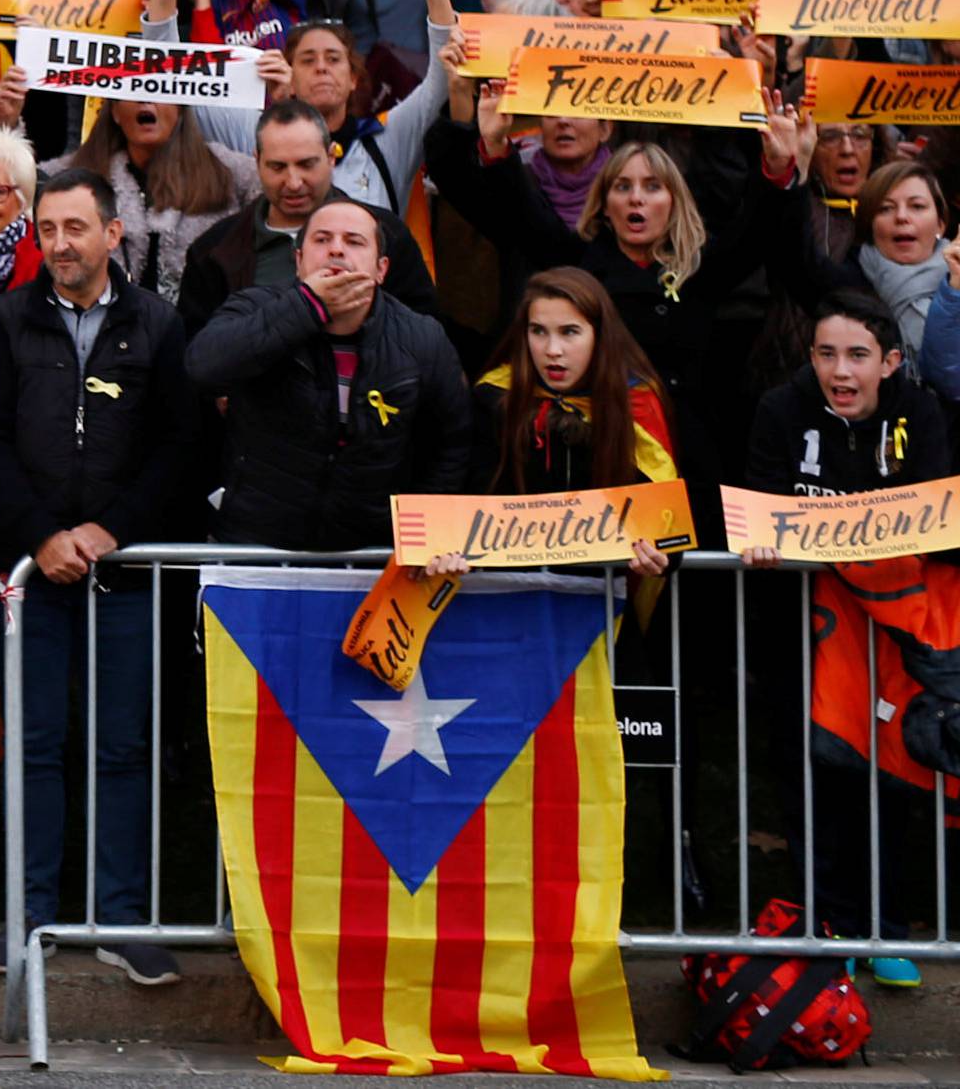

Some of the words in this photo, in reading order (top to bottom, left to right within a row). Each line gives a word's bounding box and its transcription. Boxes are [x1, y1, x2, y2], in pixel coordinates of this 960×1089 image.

[48, 38, 231, 77] LLIBERTAT
[579, 55, 624, 65] REPUBLIC
[627, 57, 639, 65] OF
[641, 58, 695, 69] CATALONIA
[45, 69, 123, 90] PRESOS
[131, 76, 230, 97] POLÍTICS!
[543, 64, 728, 110] Freedom!
[584, 107, 629, 116] POLITICAL
[632, 110, 683, 119] PRISONERS
[800, 429, 821, 477] 1
[502, 502, 525, 510] SOM
[528, 497, 581, 509] REPÚBLICA
[798, 502, 843, 510] REPUBLIC
[846, 500, 859, 508] OF
[861, 491, 918, 507] CATALONIA
[461, 496, 633, 560] Llibertat!
[771, 490, 953, 552] Freedom!
[506, 553, 543, 562] PRESOS
[546, 548, 588, 559] POLÍTICS
[815, 548, 862, 557] POLITICAL
[864, 542, 919, 554] PRISONERS
